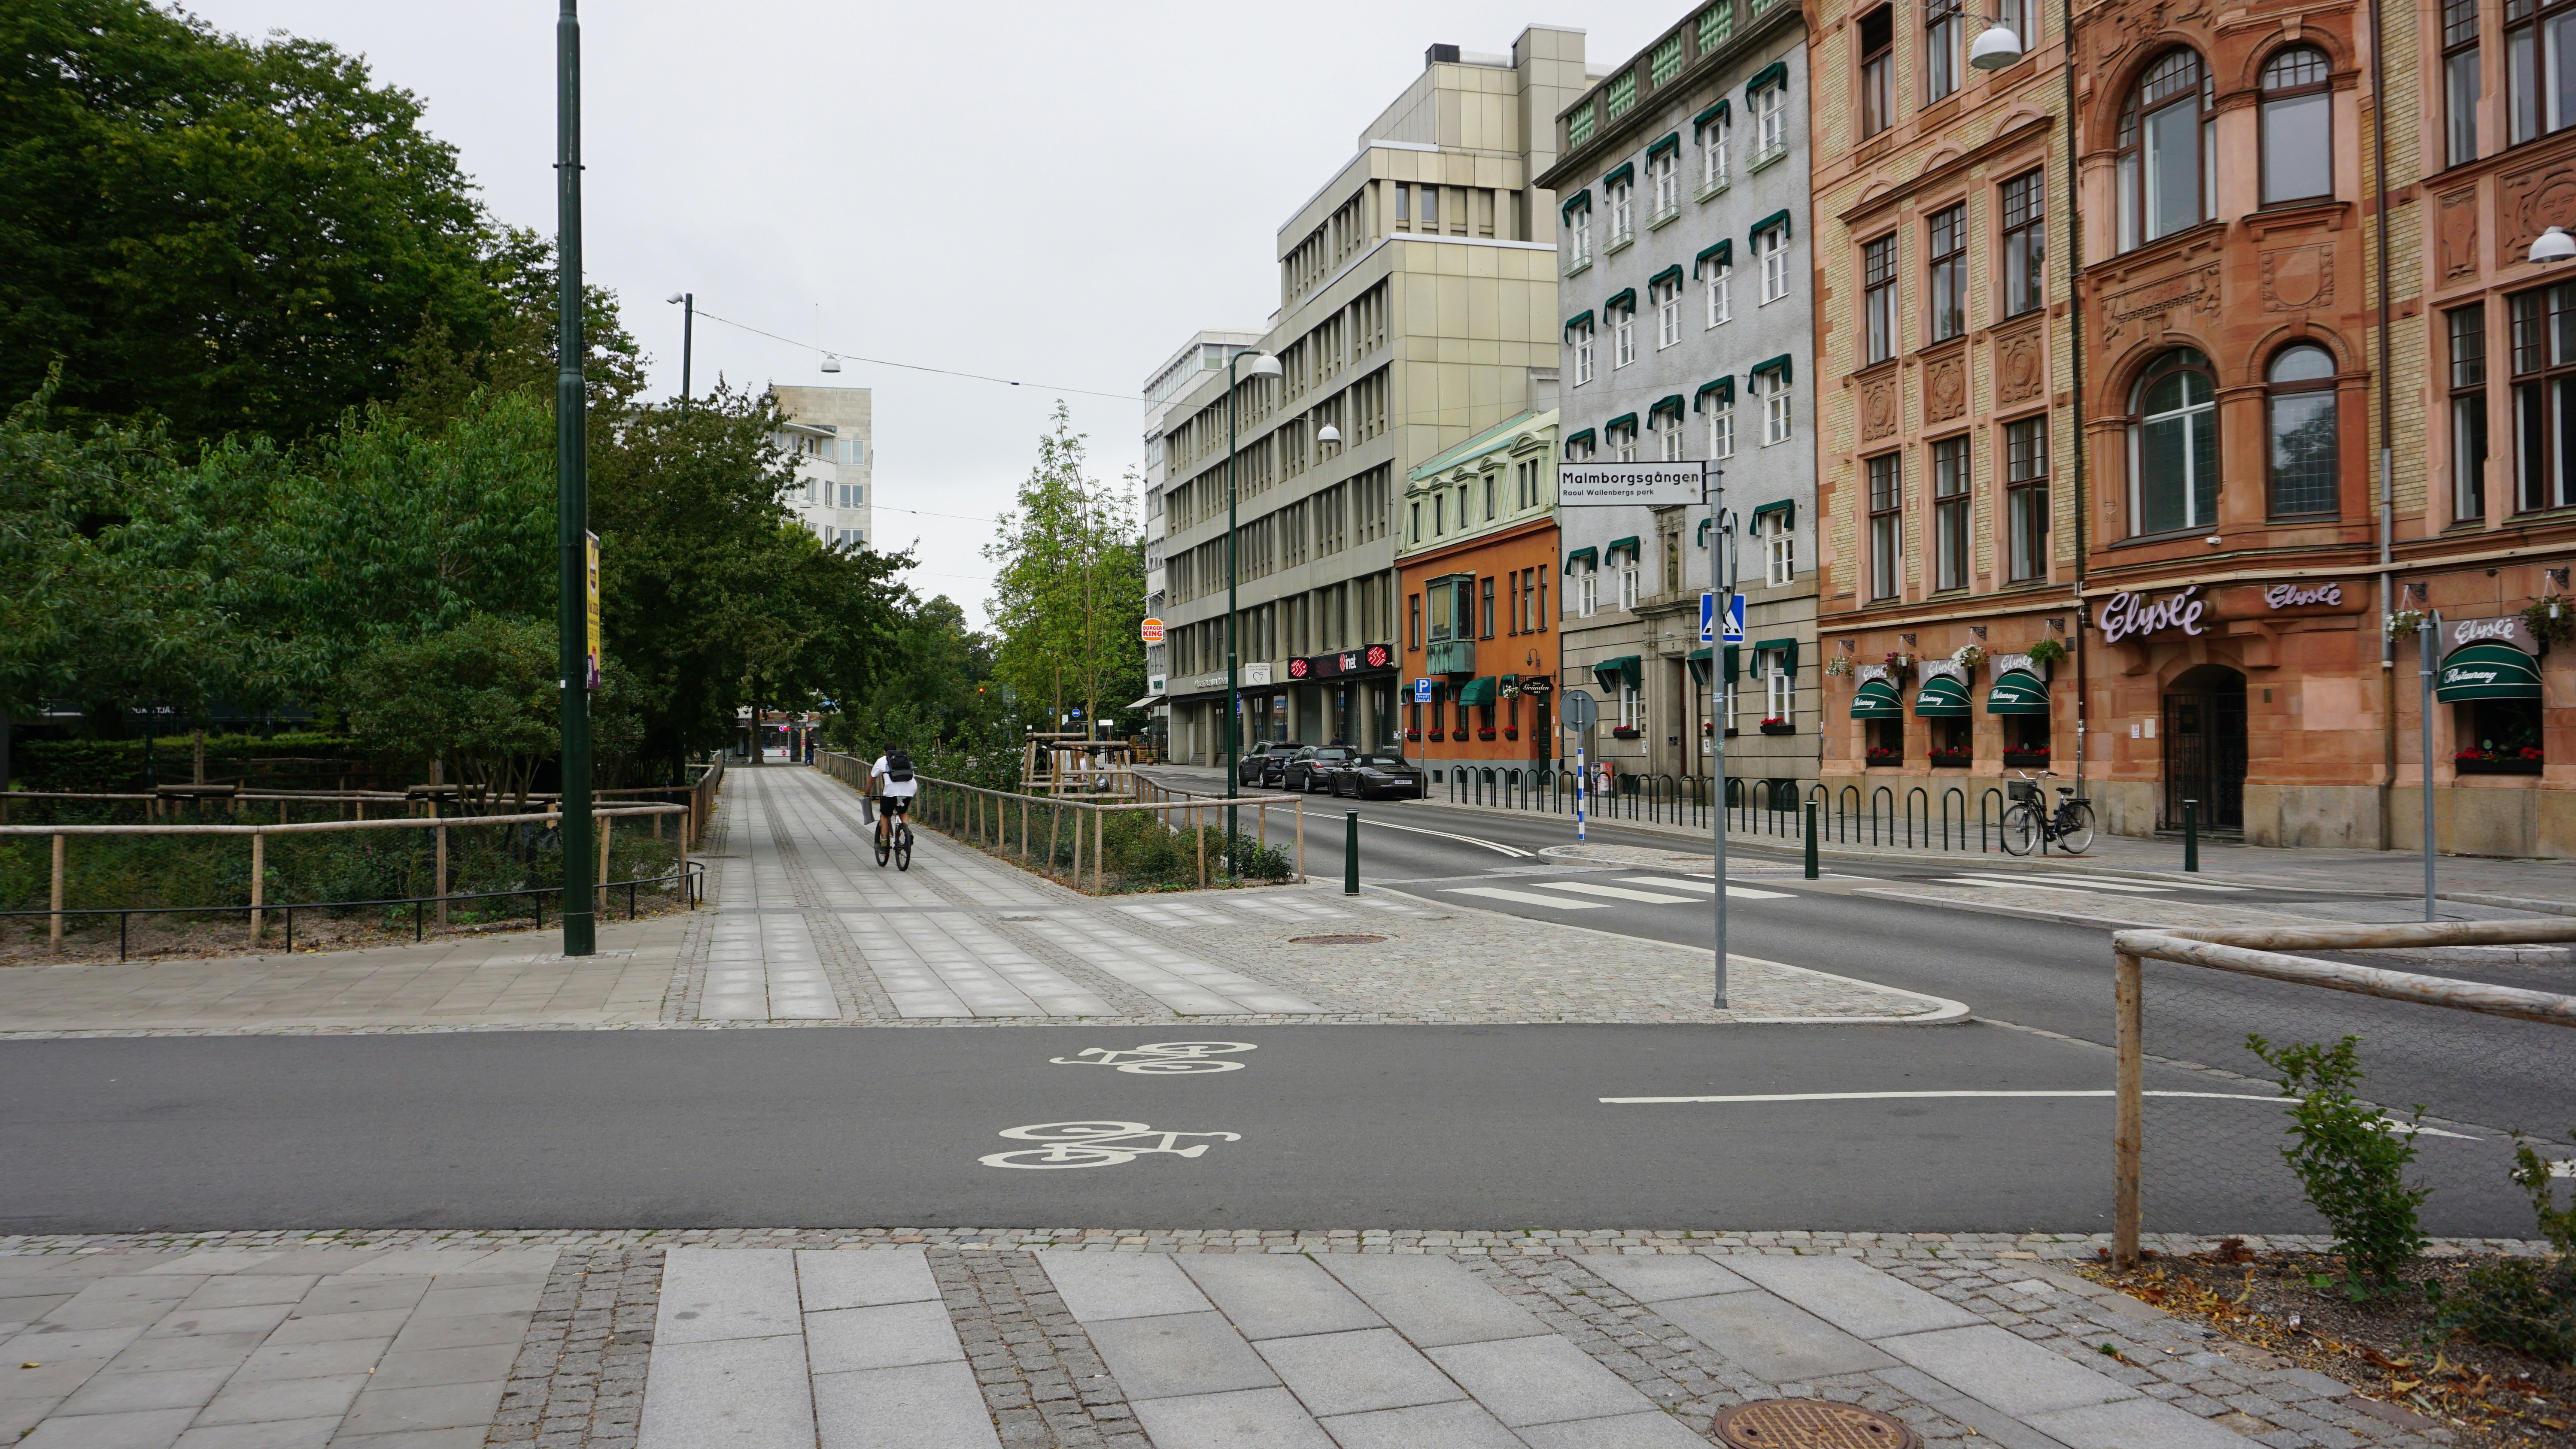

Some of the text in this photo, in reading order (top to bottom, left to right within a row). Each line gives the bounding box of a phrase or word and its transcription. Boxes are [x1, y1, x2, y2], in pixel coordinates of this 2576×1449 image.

[1563, 471, 1698, 485] Malmborgsgången
[1346, 654, 1357, 670] inet
[2444, 668, 2497, 683] Restaurang
[1419, 680, 1428, 692] P
[1853, 697, 1876, 708] Restaurang
[1918, 693, 1944, 705] Restaurang
[1990, 689, 2019, 703] Restaurang
